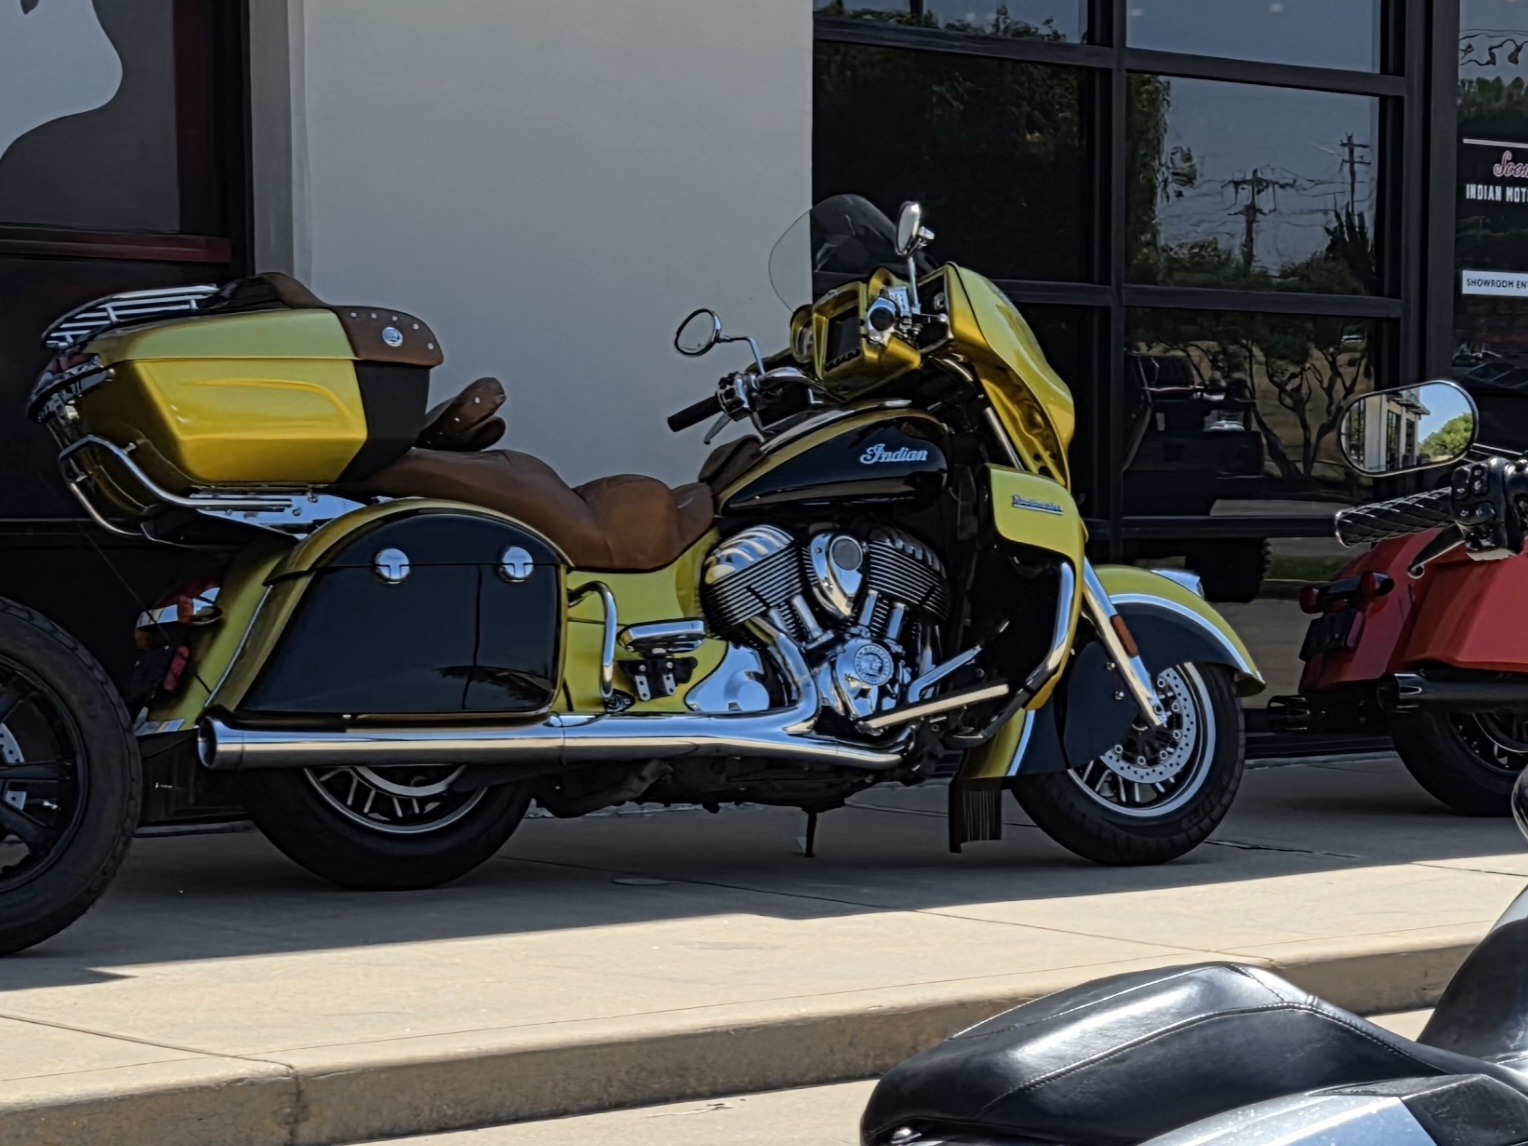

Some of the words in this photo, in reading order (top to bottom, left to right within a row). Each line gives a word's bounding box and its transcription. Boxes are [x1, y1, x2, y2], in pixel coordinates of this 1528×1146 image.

[1465, 183, 1502, 202] INDIAN
[1466, 278, 1514, 289] SHOWROOM
[860, 443, 928, 465] Indian
